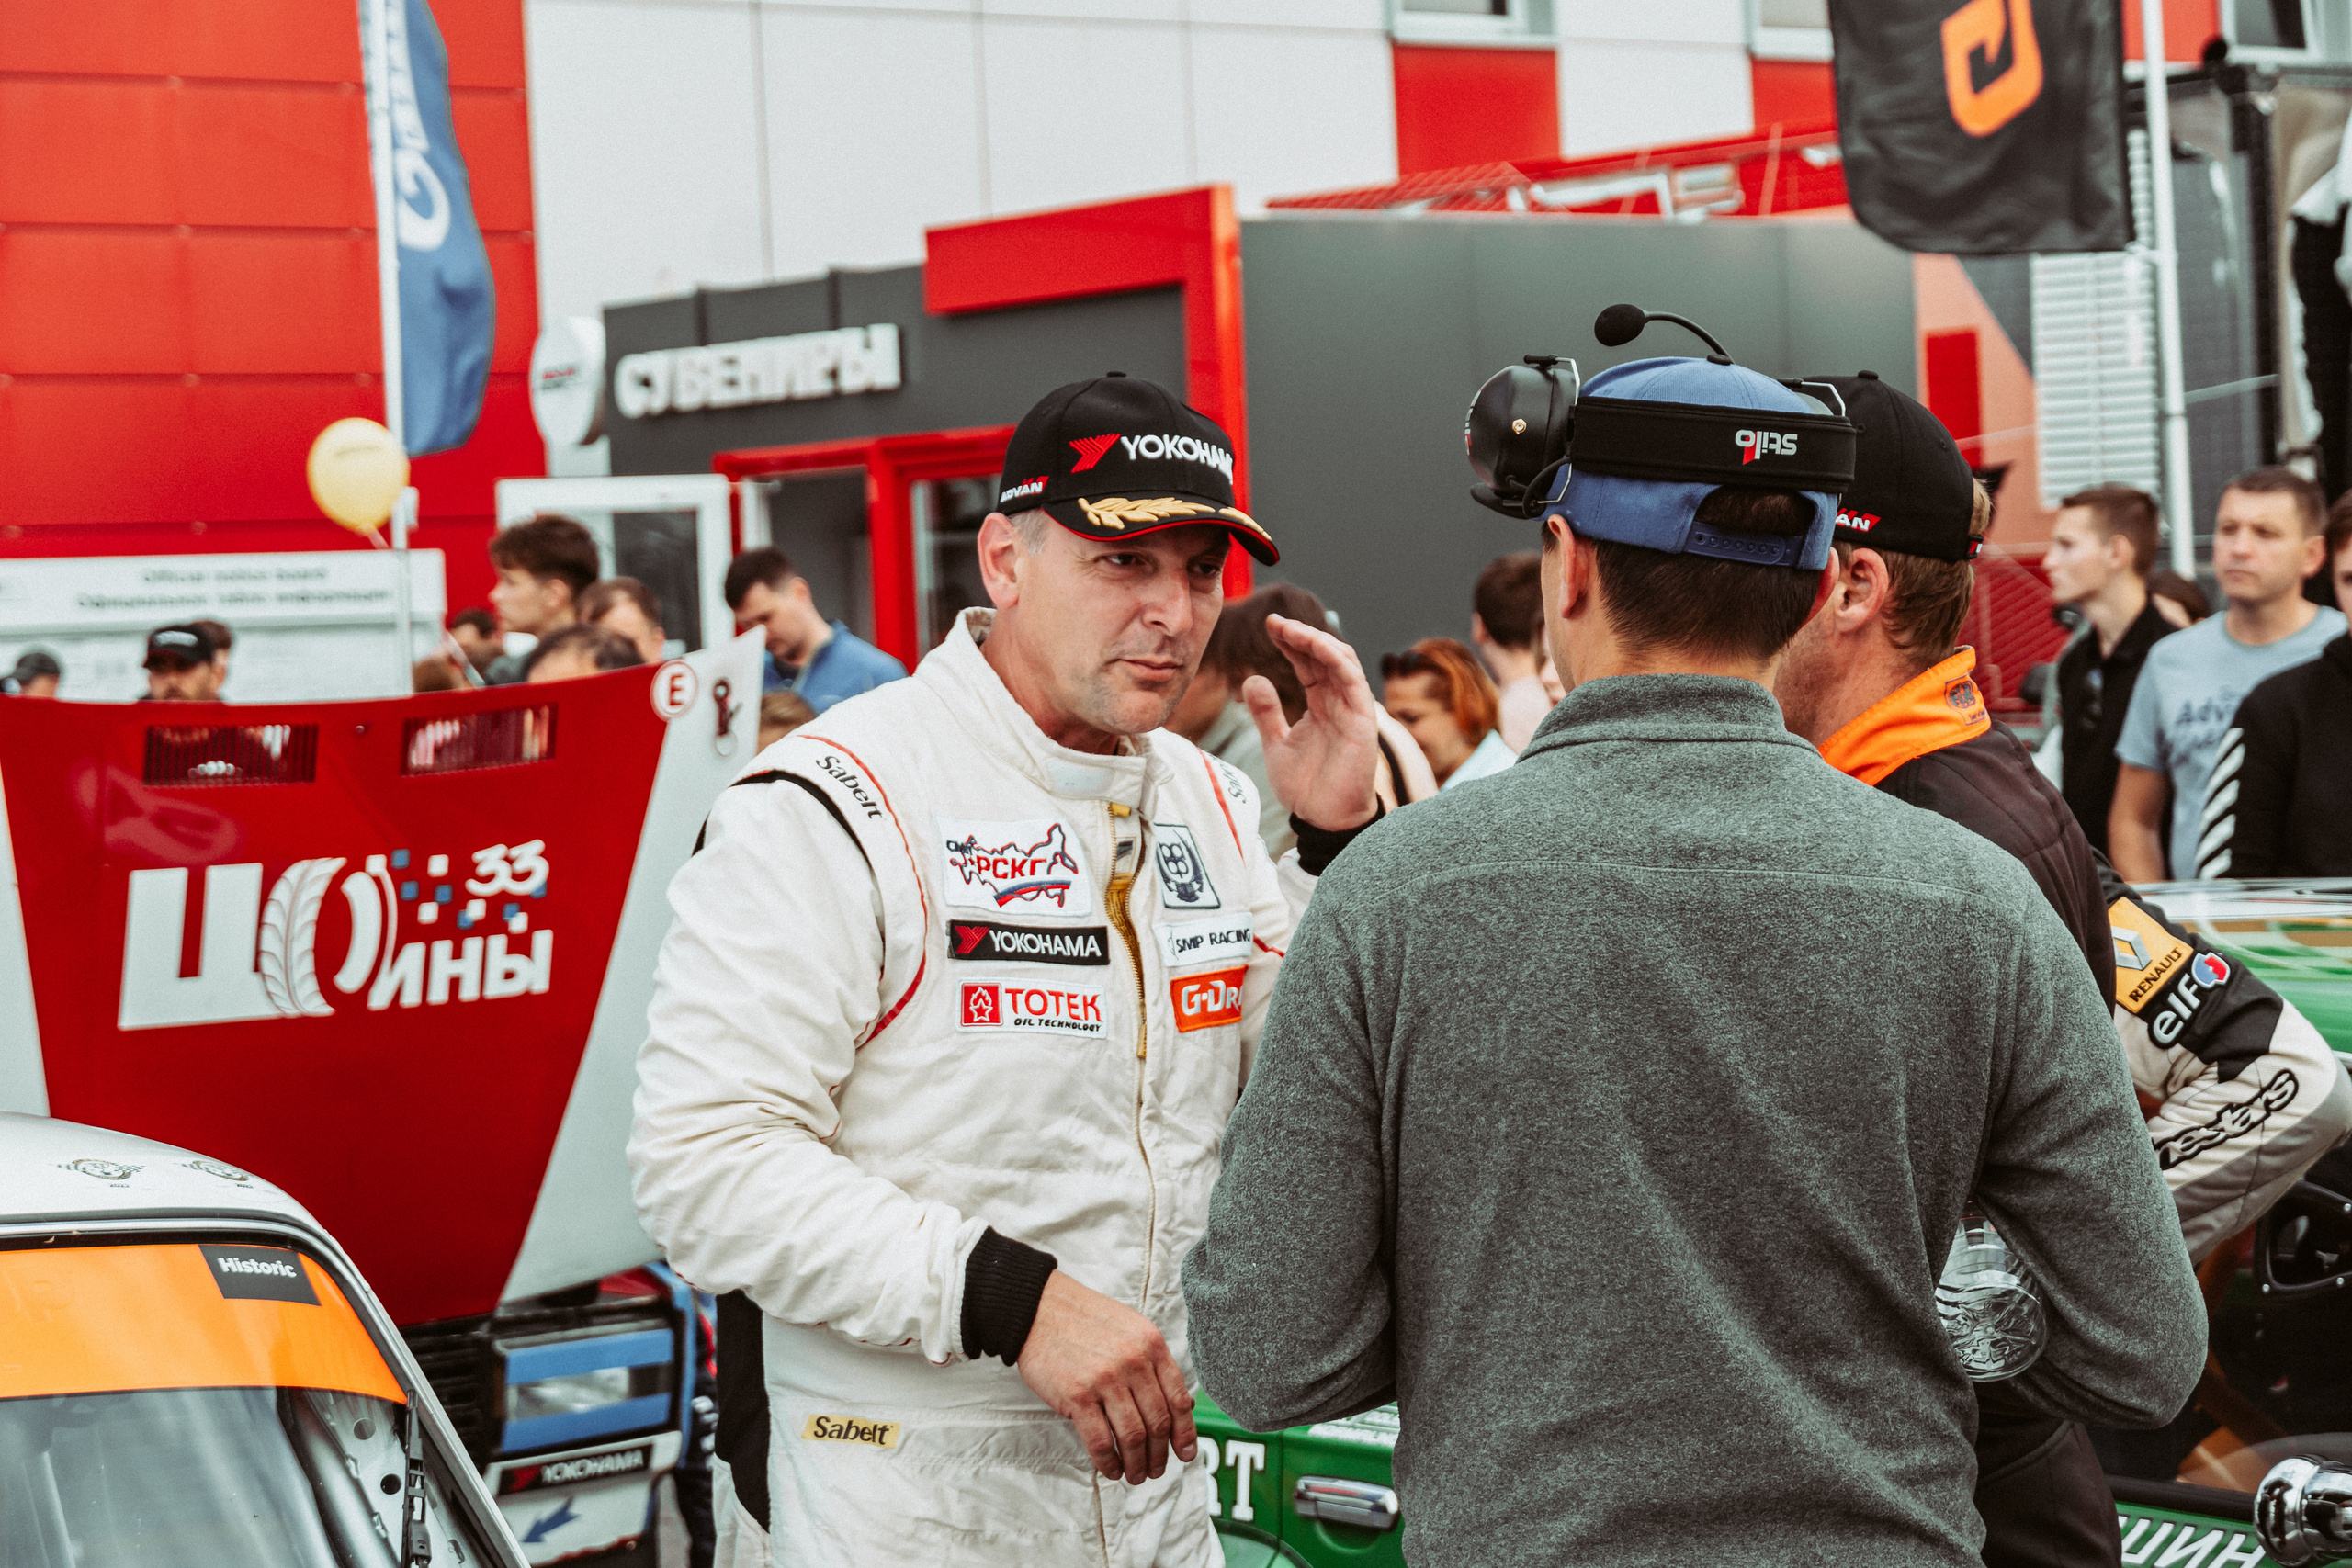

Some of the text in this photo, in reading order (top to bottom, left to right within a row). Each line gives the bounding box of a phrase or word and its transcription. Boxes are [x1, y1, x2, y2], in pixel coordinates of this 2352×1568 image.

[1120, 434, 1233, 485] YOKOHAM
[1000, 481, 1043, 502] ADVAN
[669, 672, 684, 706] E
[815, 755, 883, 819] Sabelt
[465, 839, 550, 897] 33
[976, 855, 1046, 879] РСКГ
[989, 930, 1102, 957] YOKOHAMA
[1176, 935, 1204, 953] SMP
[2129, 946, 2182, 1002] RENAULT
[1005, 988, 1103, 1022] TOTEK
[2153, 973, 2201, 1044] elf
[1014, 1017, 1102, 1032] OIL TECHNOLOGY
[217, 1257, 298, 1278] Historic
[813, 1416, 890, 1445] Sabelt
[541, 1449, 644, 1484] YOKOHAMA
